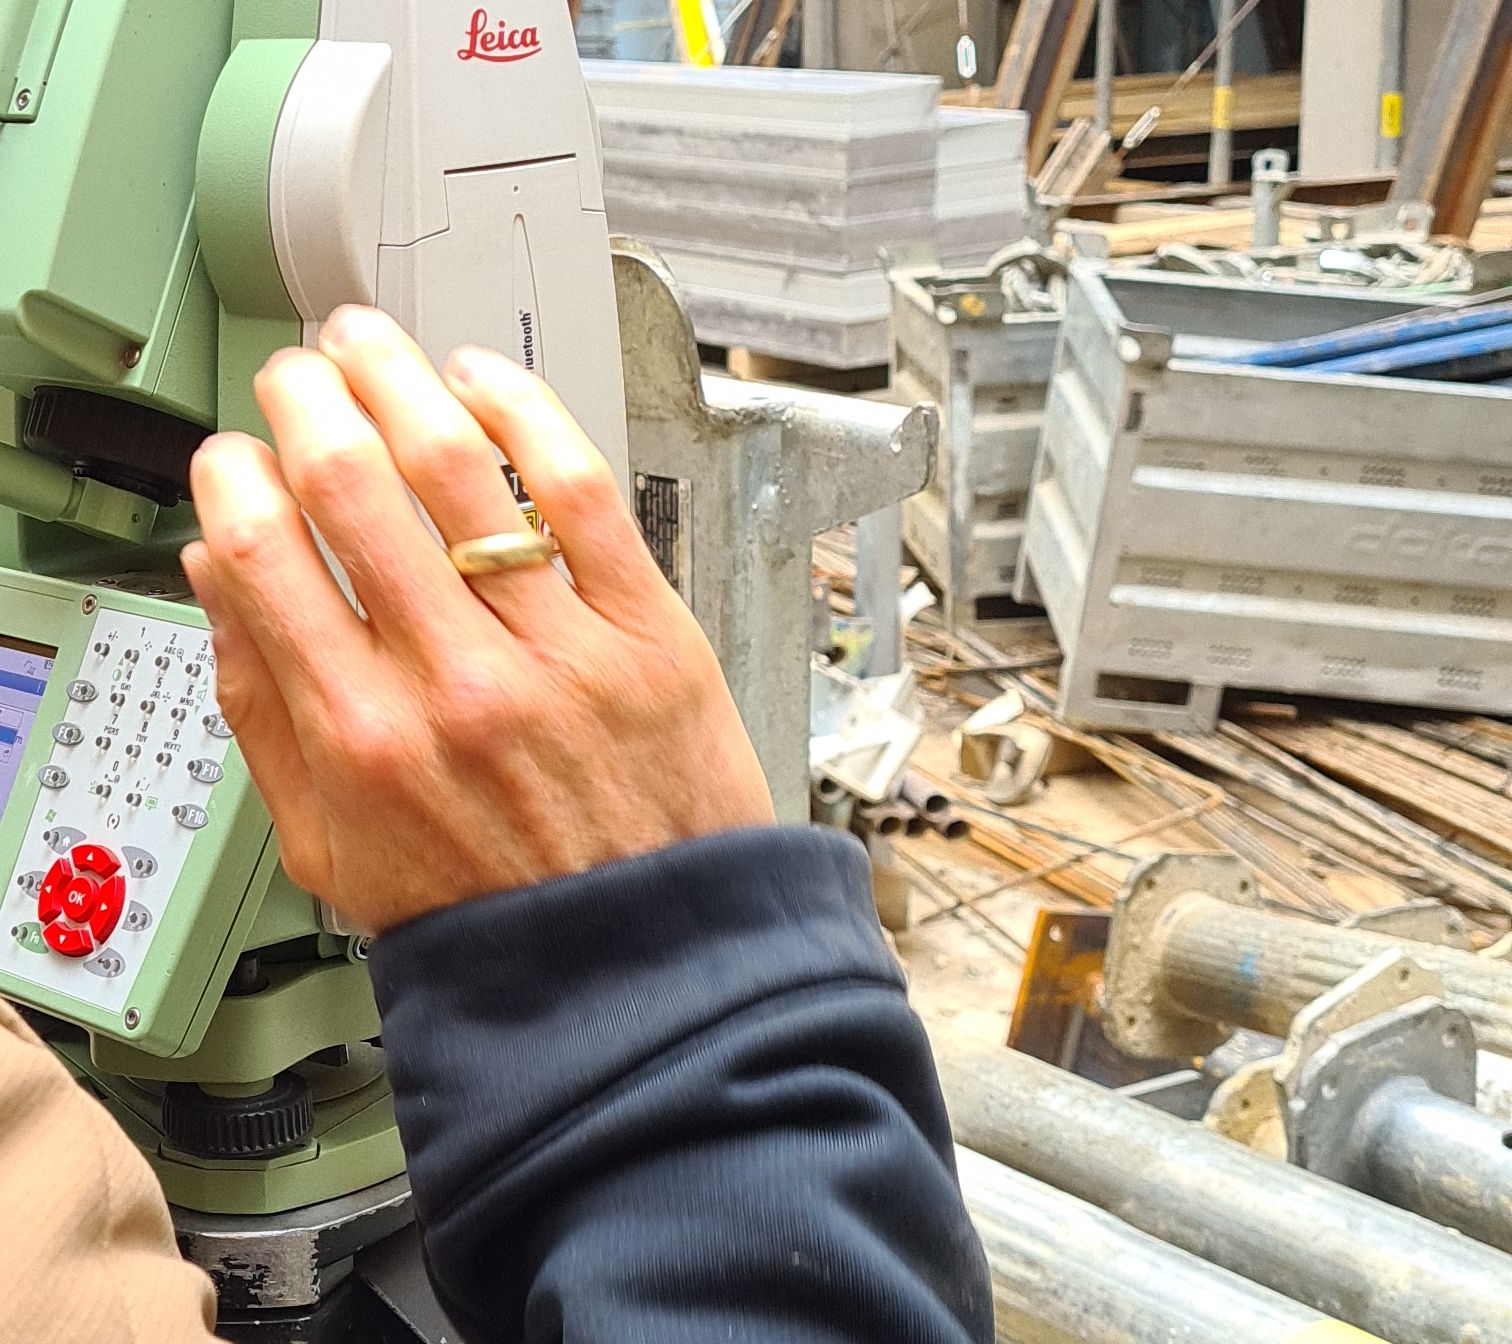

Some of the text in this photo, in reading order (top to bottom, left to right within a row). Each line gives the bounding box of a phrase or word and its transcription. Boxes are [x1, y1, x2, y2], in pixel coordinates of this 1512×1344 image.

[457, 8, 542, 62] Leica
[519, 312, 534, 372] luetooth
[140, 627, 146, 637] 1
[170, 633, 177, 644] 2
[201, 640, 208, 651] 3
[156, 677, 163, 688] 5
[187, 685, 194, 696] 6
[112, 714, 118, 725] 7
[142, 721, 148, 732] 8
[172, 729, 179, 740] 9
[113, 761, 119, 772] 0
[202, 765, 219, 778] F11
[188, 812, 204, 825] F10
[68, 890, 86, 906] OK
